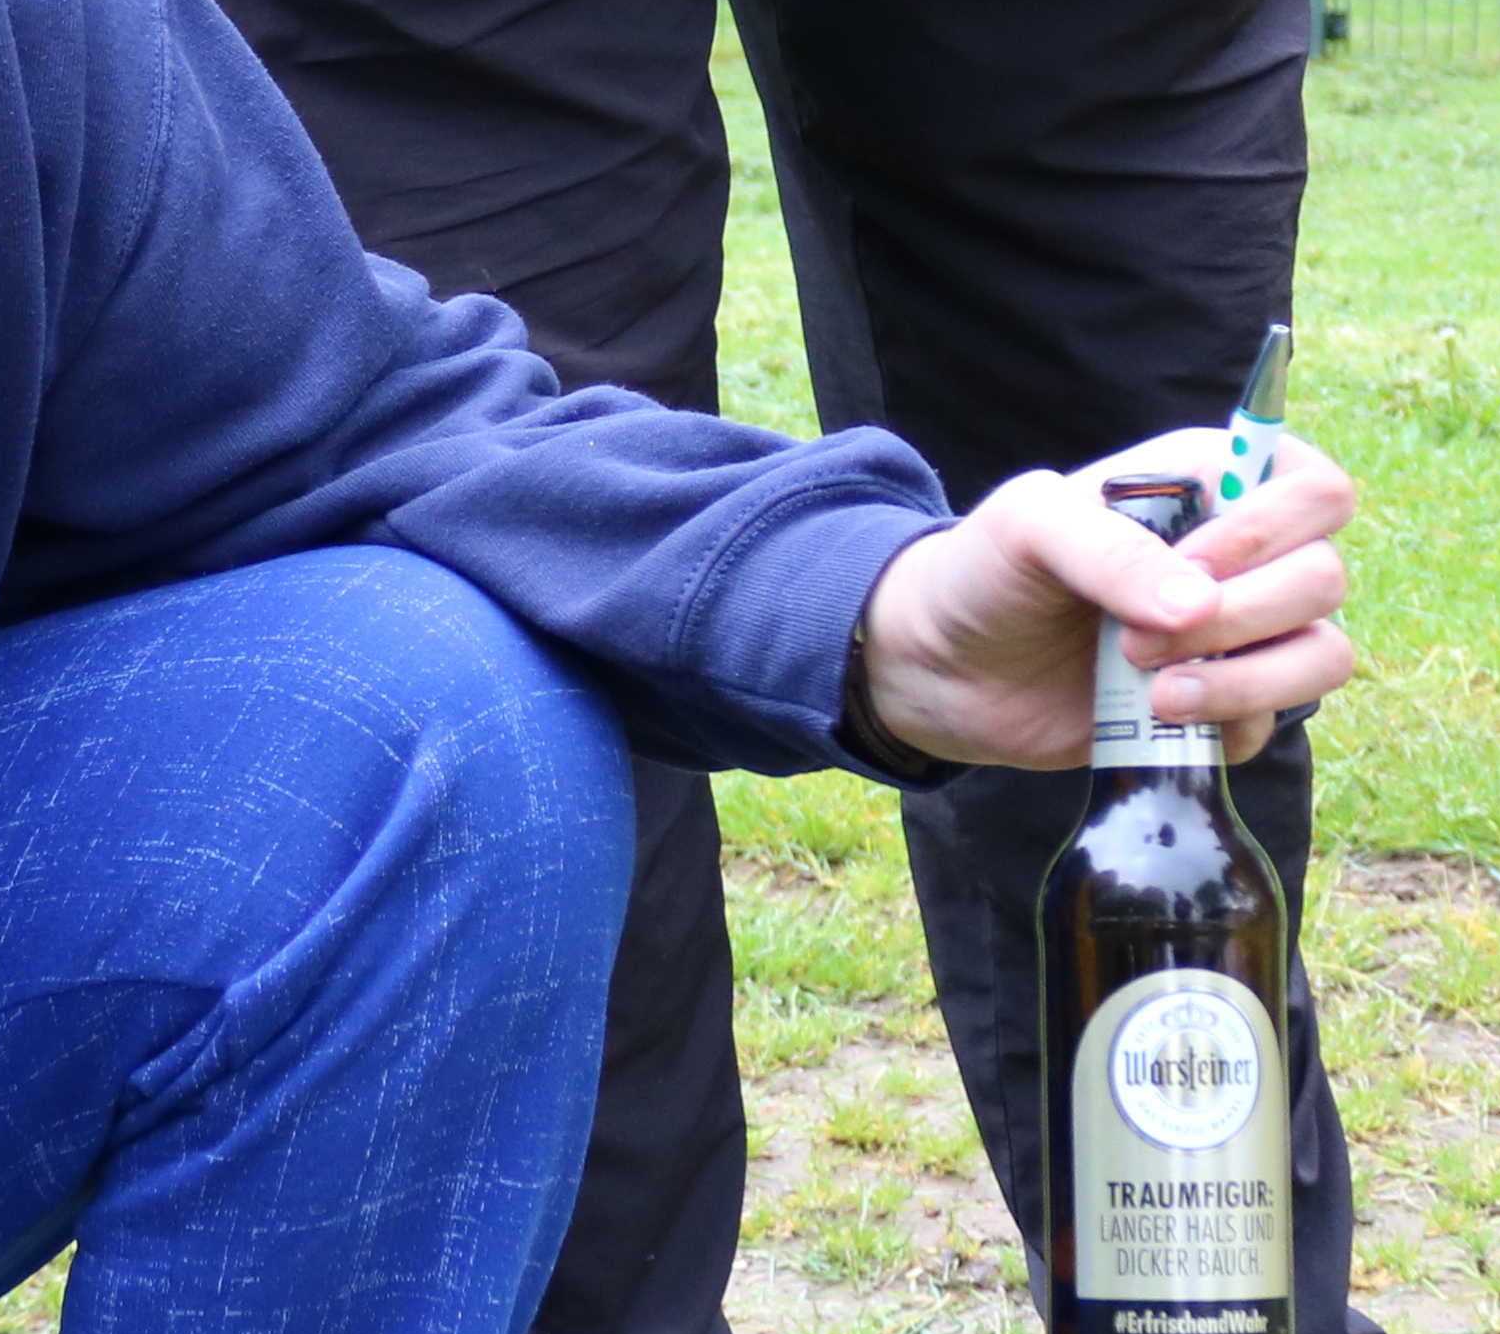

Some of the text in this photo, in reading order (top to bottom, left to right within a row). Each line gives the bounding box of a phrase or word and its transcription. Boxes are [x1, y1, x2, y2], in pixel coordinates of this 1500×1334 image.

[1123, 1045, 1254, 1092] Warsteiner
[1106, 1180, 1274, 1209] TRAUMFIGUR:
[1100, 1214, 1275, 1243] LANGER HALS UND
[1116, 1248, 1189, 1276] DICKER
